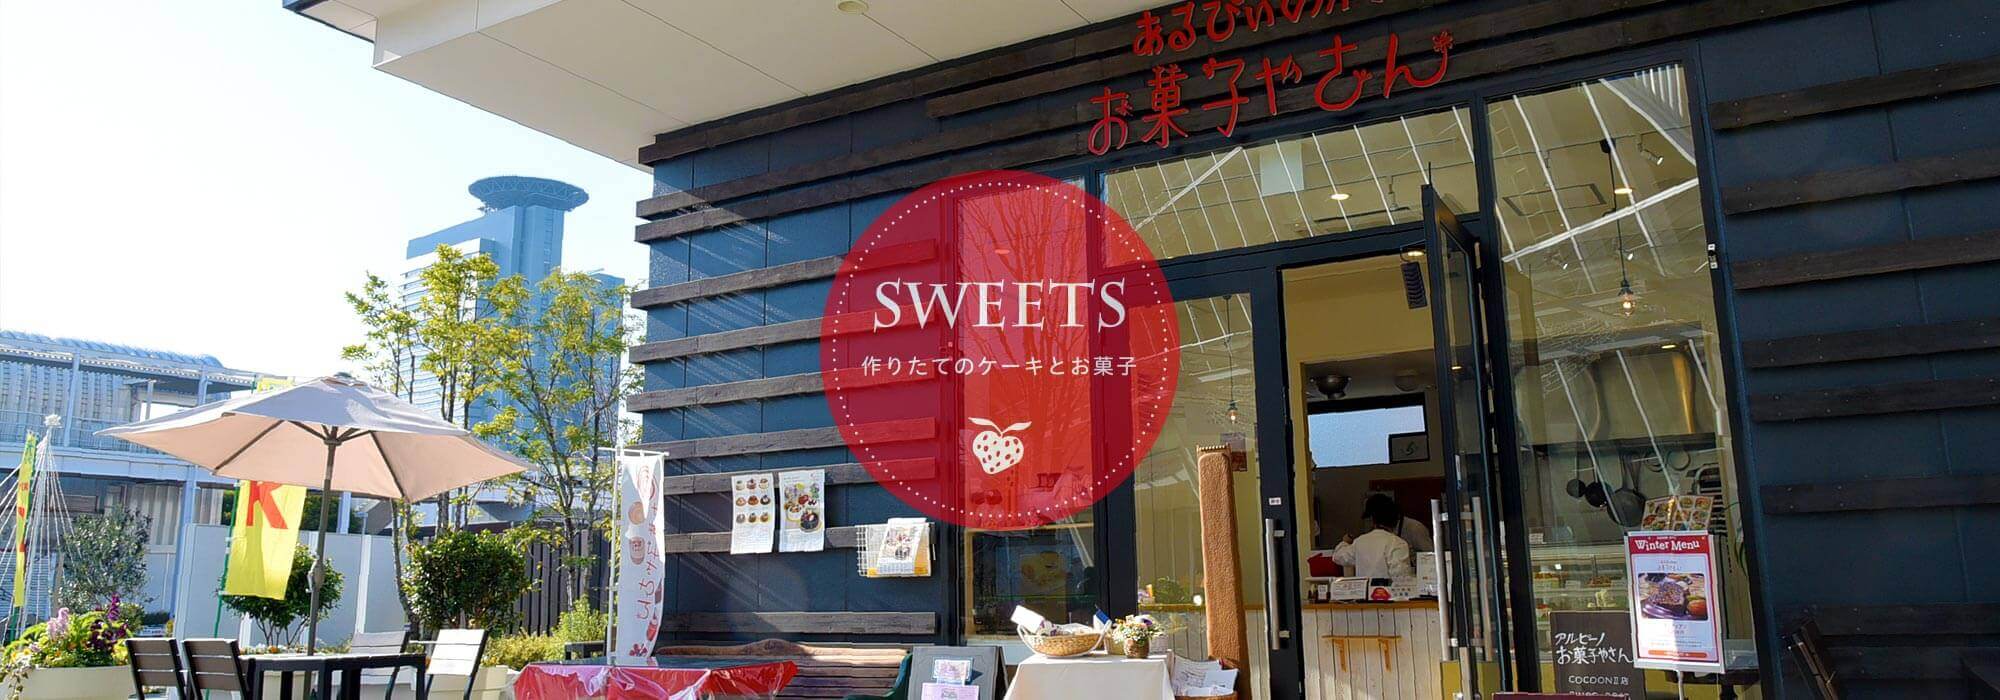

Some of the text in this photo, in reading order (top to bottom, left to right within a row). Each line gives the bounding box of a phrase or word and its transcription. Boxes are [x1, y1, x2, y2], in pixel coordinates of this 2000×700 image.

[1088, 30, 1454, 155] お菓子やさん
[1634, 539, 1700, 551] Winter Menu
[1555, 645, 1634, 665] お菓子やさん
